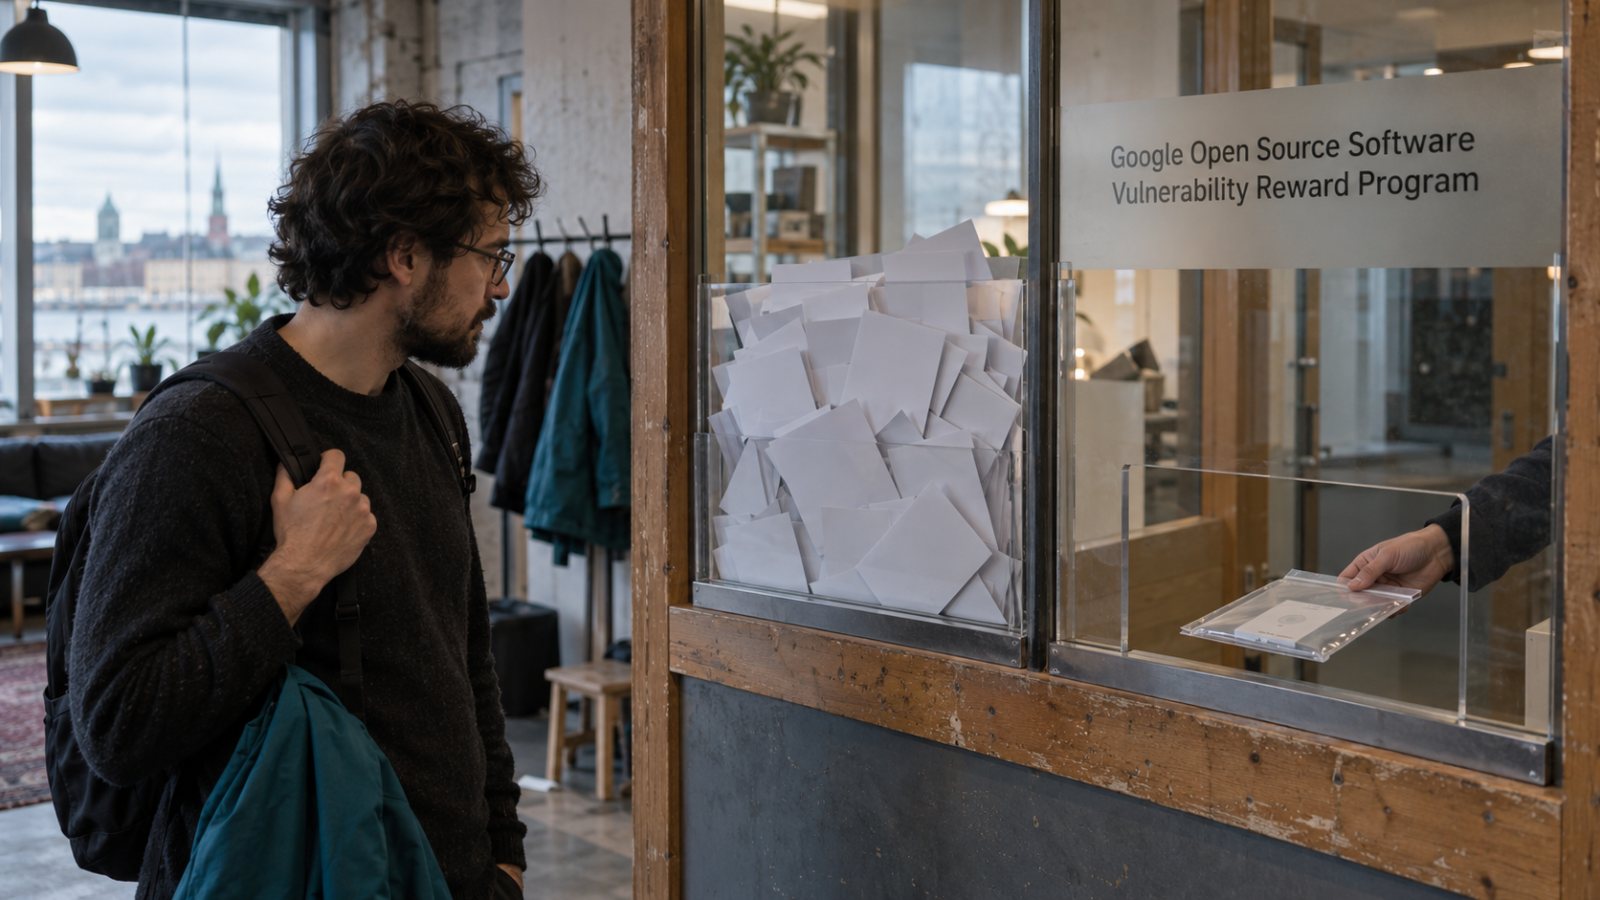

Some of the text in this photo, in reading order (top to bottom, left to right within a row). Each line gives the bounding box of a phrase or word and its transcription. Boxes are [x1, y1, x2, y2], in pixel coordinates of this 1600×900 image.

[1110, 129, 1476, 172] Google Open Source Software
[1111, 170, 1480, 206] Vulnerability Reward Program
